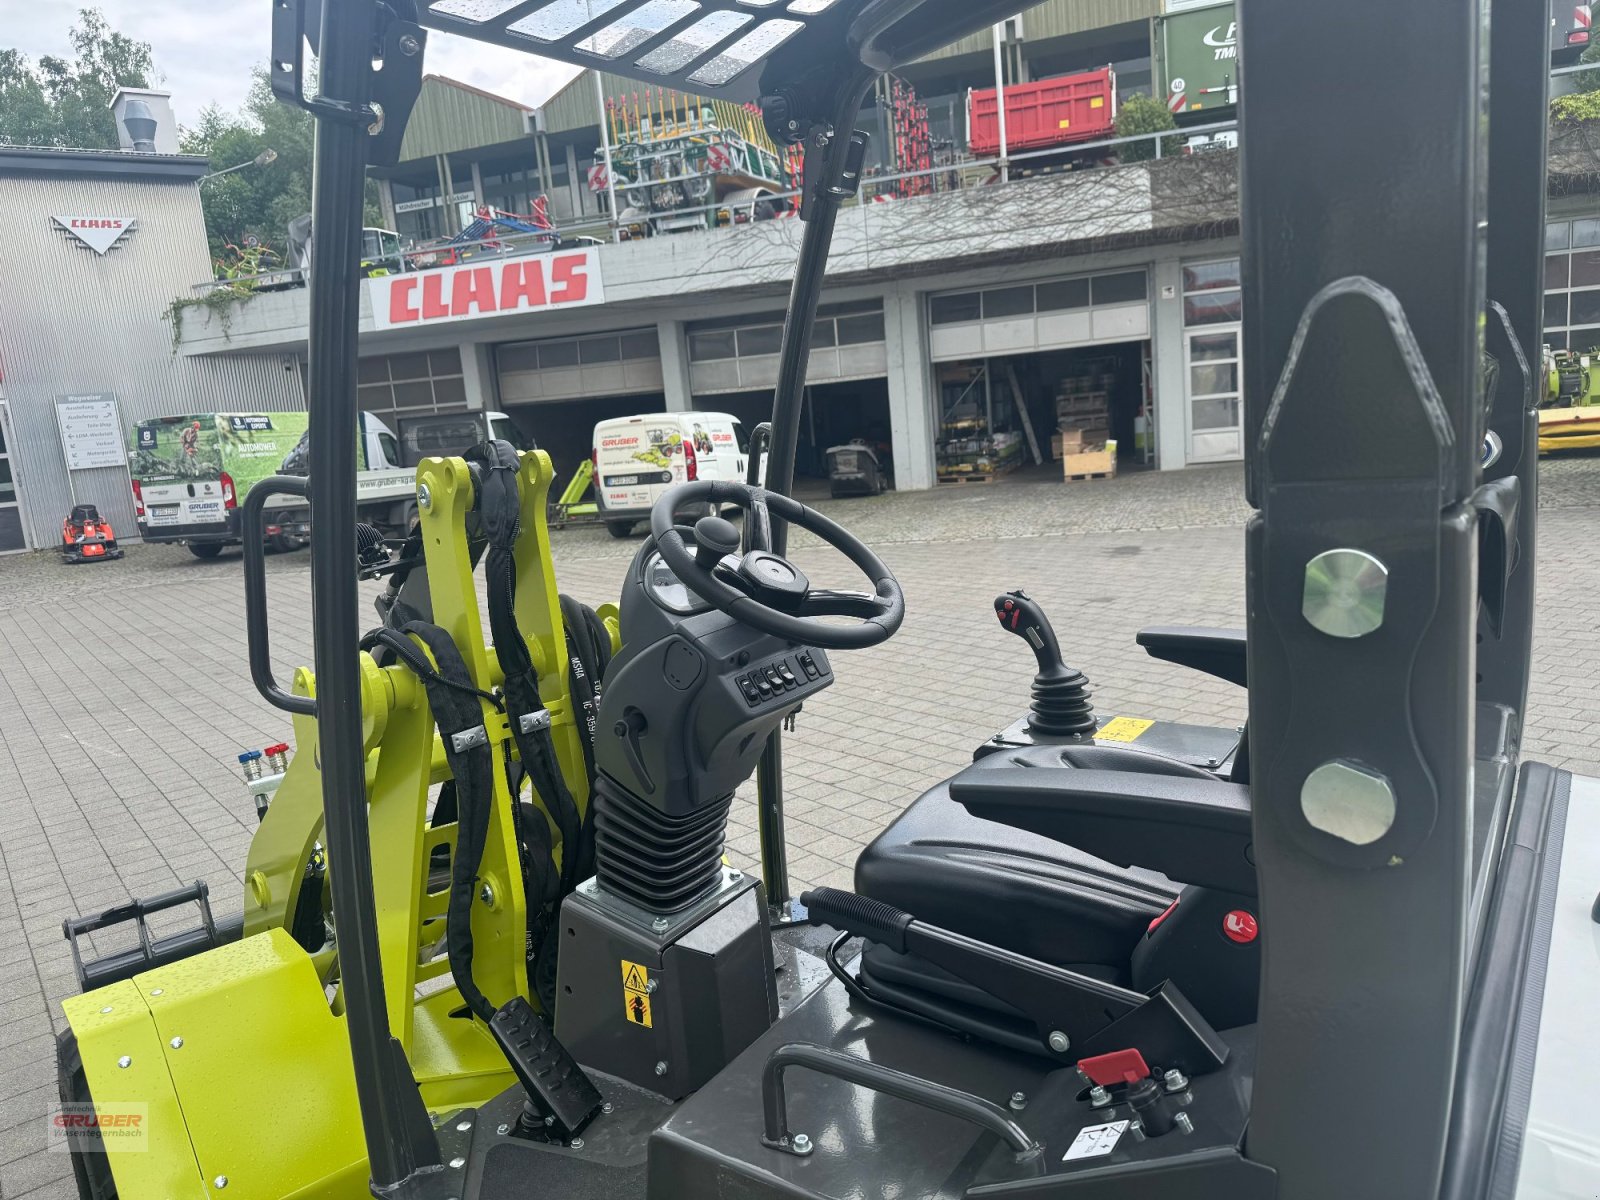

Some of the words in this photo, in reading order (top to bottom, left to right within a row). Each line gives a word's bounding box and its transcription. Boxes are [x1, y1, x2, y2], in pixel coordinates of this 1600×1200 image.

[1173, 81, 1182, 90] 40
[71, 219, 122, 229] CLAAS
[390, 253, 588, 324] CLAAS
[602, 437, 639, 447] GRUBER
[188, 502, 219, 510] GRUBER
[571, 657, 585, 680] MSHA
